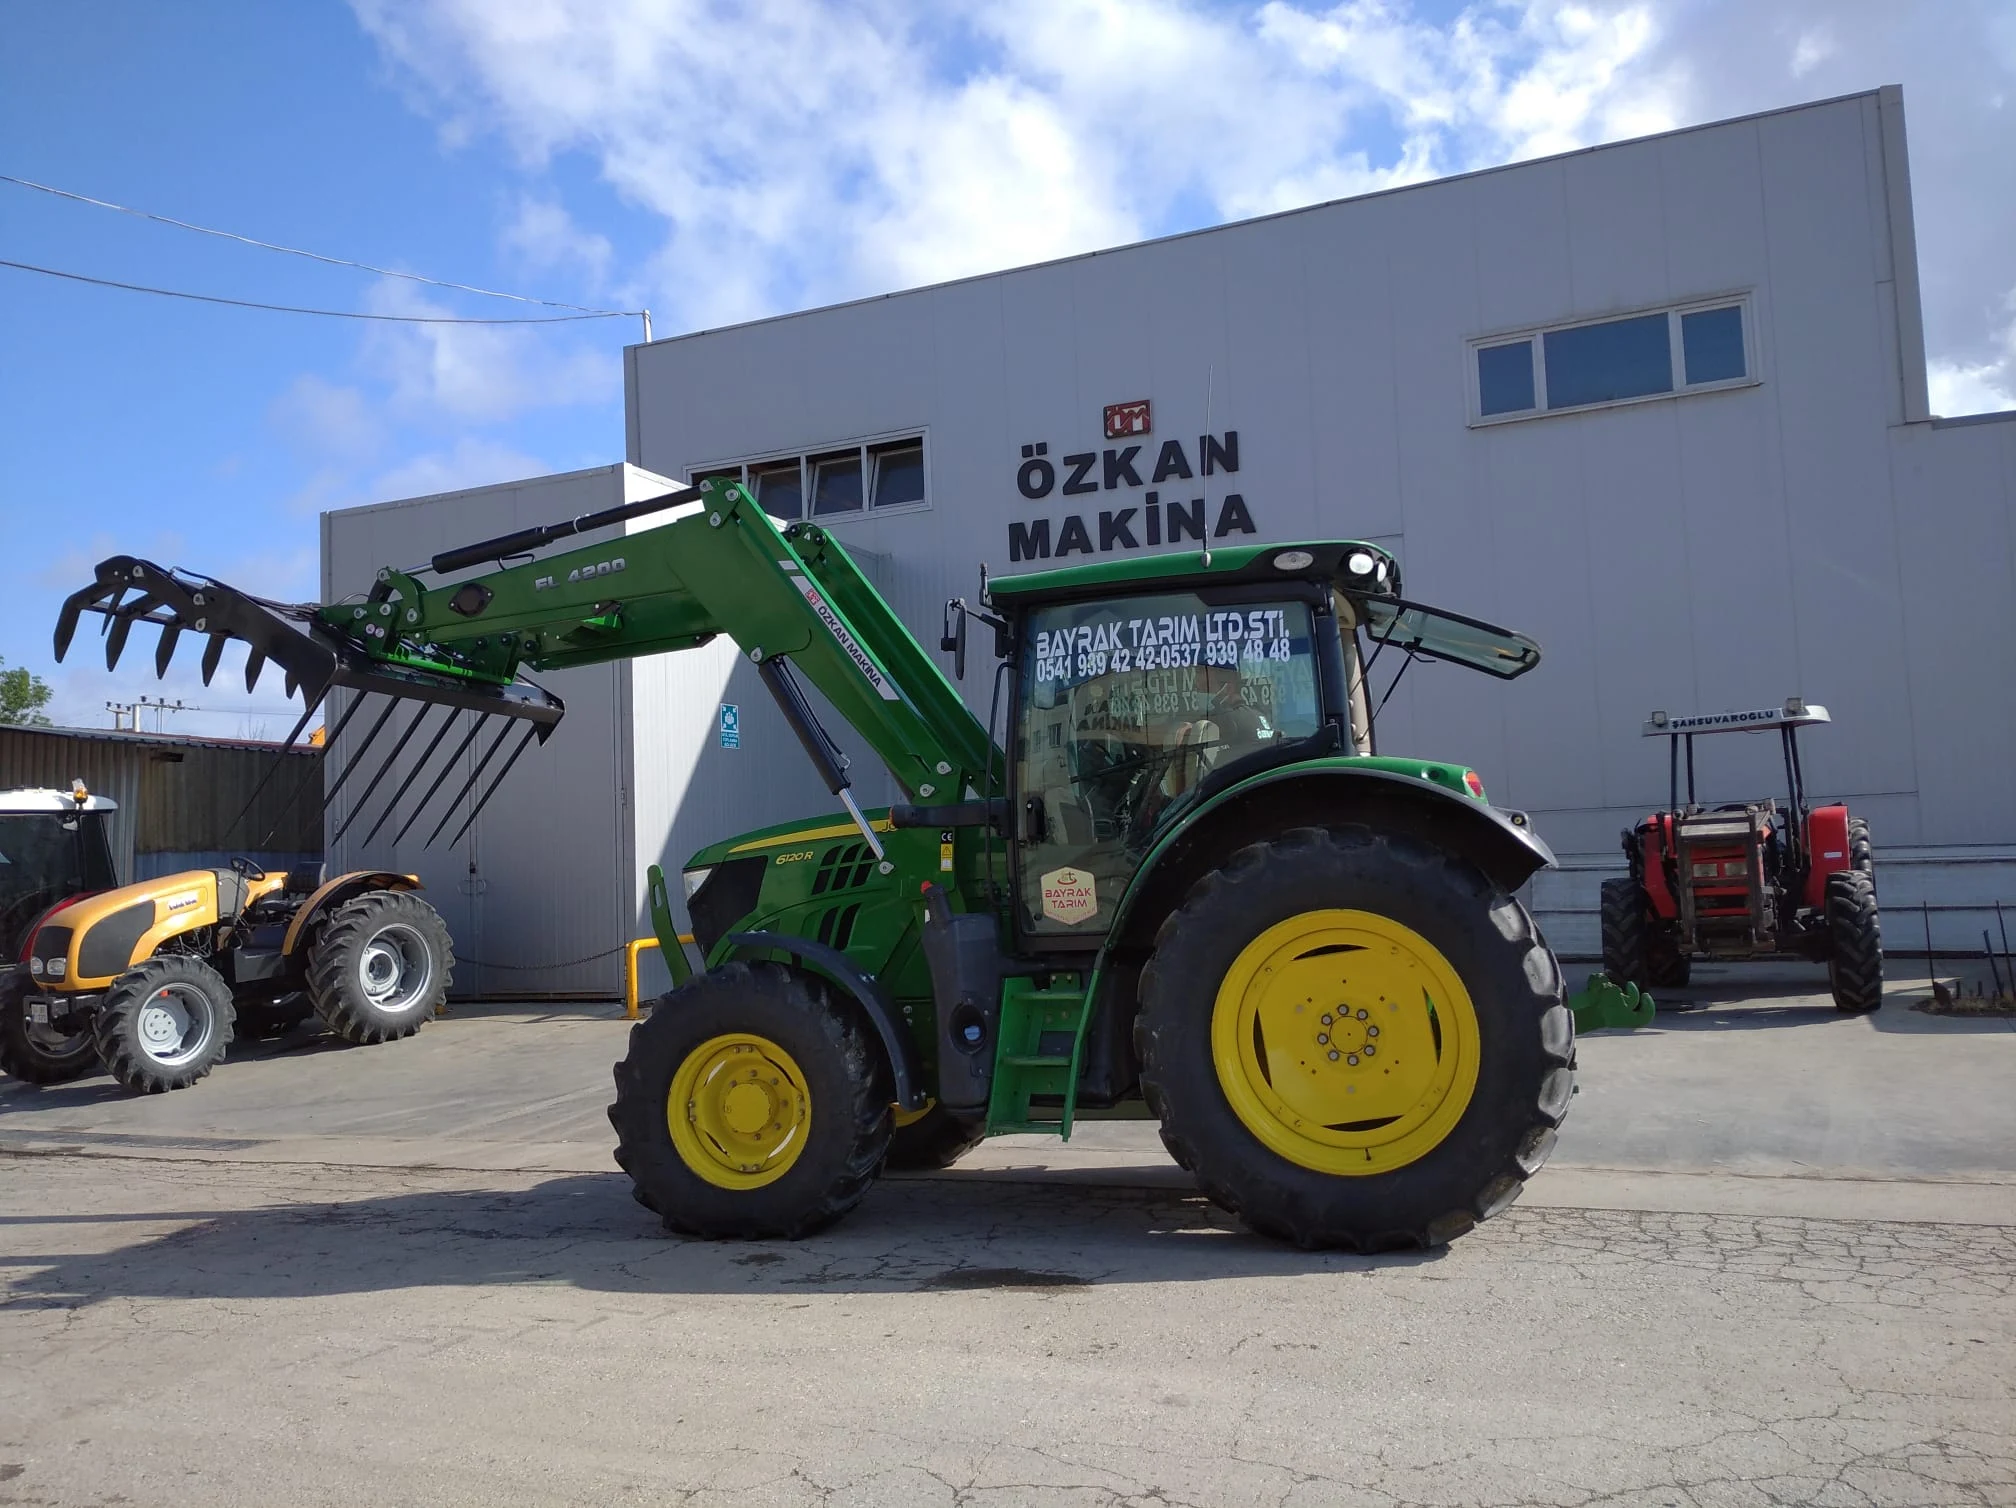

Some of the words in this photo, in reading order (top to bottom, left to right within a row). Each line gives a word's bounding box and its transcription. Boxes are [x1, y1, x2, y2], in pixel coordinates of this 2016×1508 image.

[1017, 430, 1240, 499] ÖZKAN
[1008, 491, 1257, 562] MAKİNA
[535, 575, 560, 592] FL
[567, 557, 626, 584] 4200
[1036, 621, 1123, 659] BAYRAK
[1128, 614, 1200, 647] TARIM
[1036, 655, 1072, 682] 0541
[1077, 651, 1107, 677] 939
[1110, 648, 1131, 673] 42
[1135, 641, 1201, 670] 42-0537
[1206, 639, 1238, 666] 939
[1242, 638, 1264, 663] 48
[1269, 637, 1291, 662] 48
[1045, 887, 1092, 898] BAYRAK
[1051, 899, 1088, 909] TARIM
